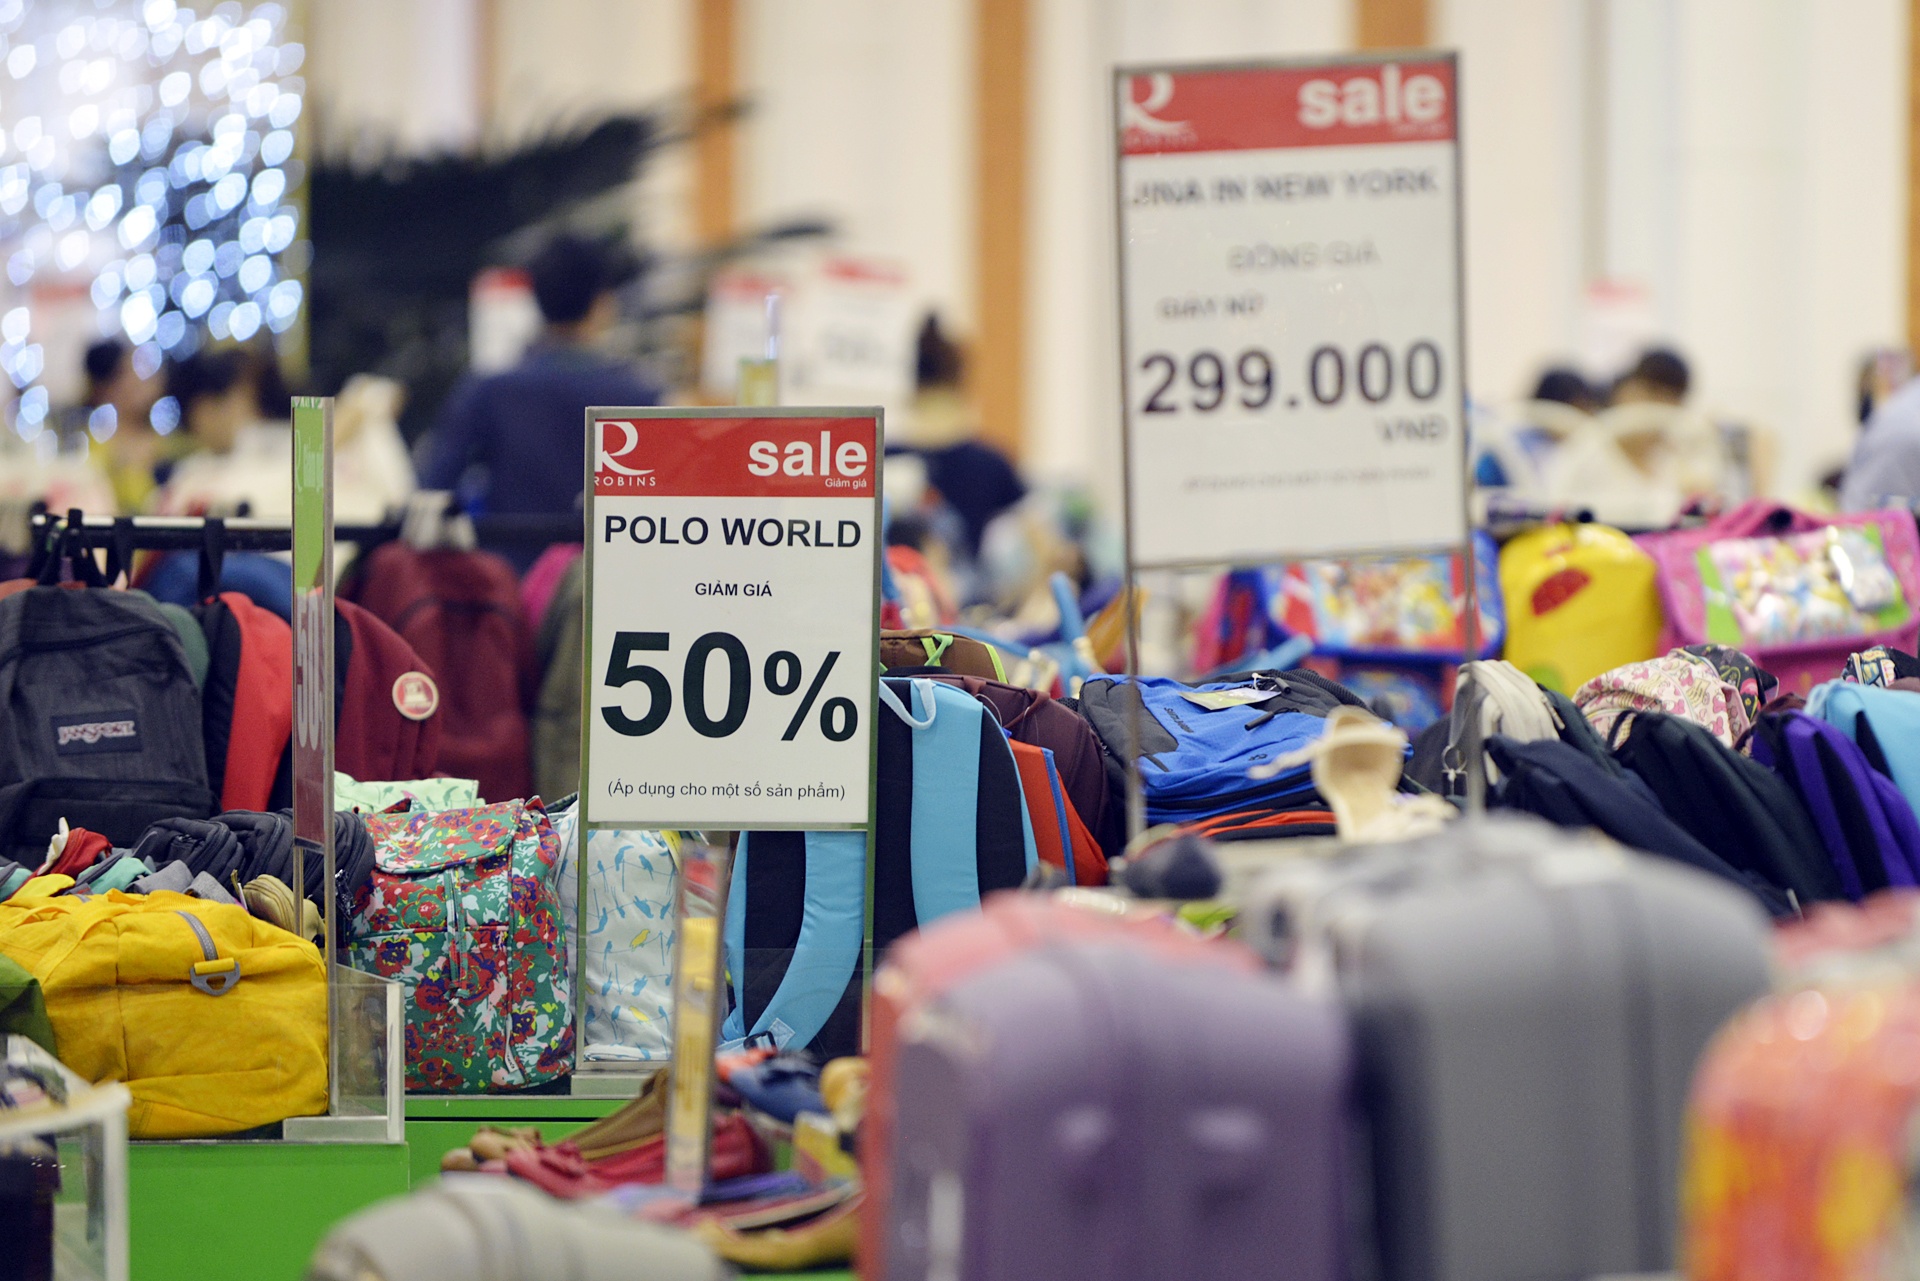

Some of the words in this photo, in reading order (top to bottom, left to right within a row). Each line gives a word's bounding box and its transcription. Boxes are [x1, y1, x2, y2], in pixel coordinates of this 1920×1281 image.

[1296, 62, 1447, 129] sale
[1253, 171, 1333, 201] NEW
[1340, 167, 1437, 196] YORK
[1141, 339, 1442, 414] 299.000
[747, 430, 868, 477] sale
[825, 477, 850, 488] Giảm
[852, 478, 867, 489] giá
[604, 515, 709, 545] POLO
[721, 517, 861, 548] WORLD
[695, 580, 738, 596] GIẢM
[743, 581, 773, 597] GIÁ
[601, 631, 859, 742] 50%
[607, 778, 634, 798] (Áp
[638, 781, 675, 798] dụng
[680, 782, 707, 796] cho
[712, 783, 739, 799] một
[744, 780, 761, 797] số
[766, 782, 793, 798] sản
[797, 781, 846, 801] phẩm)
